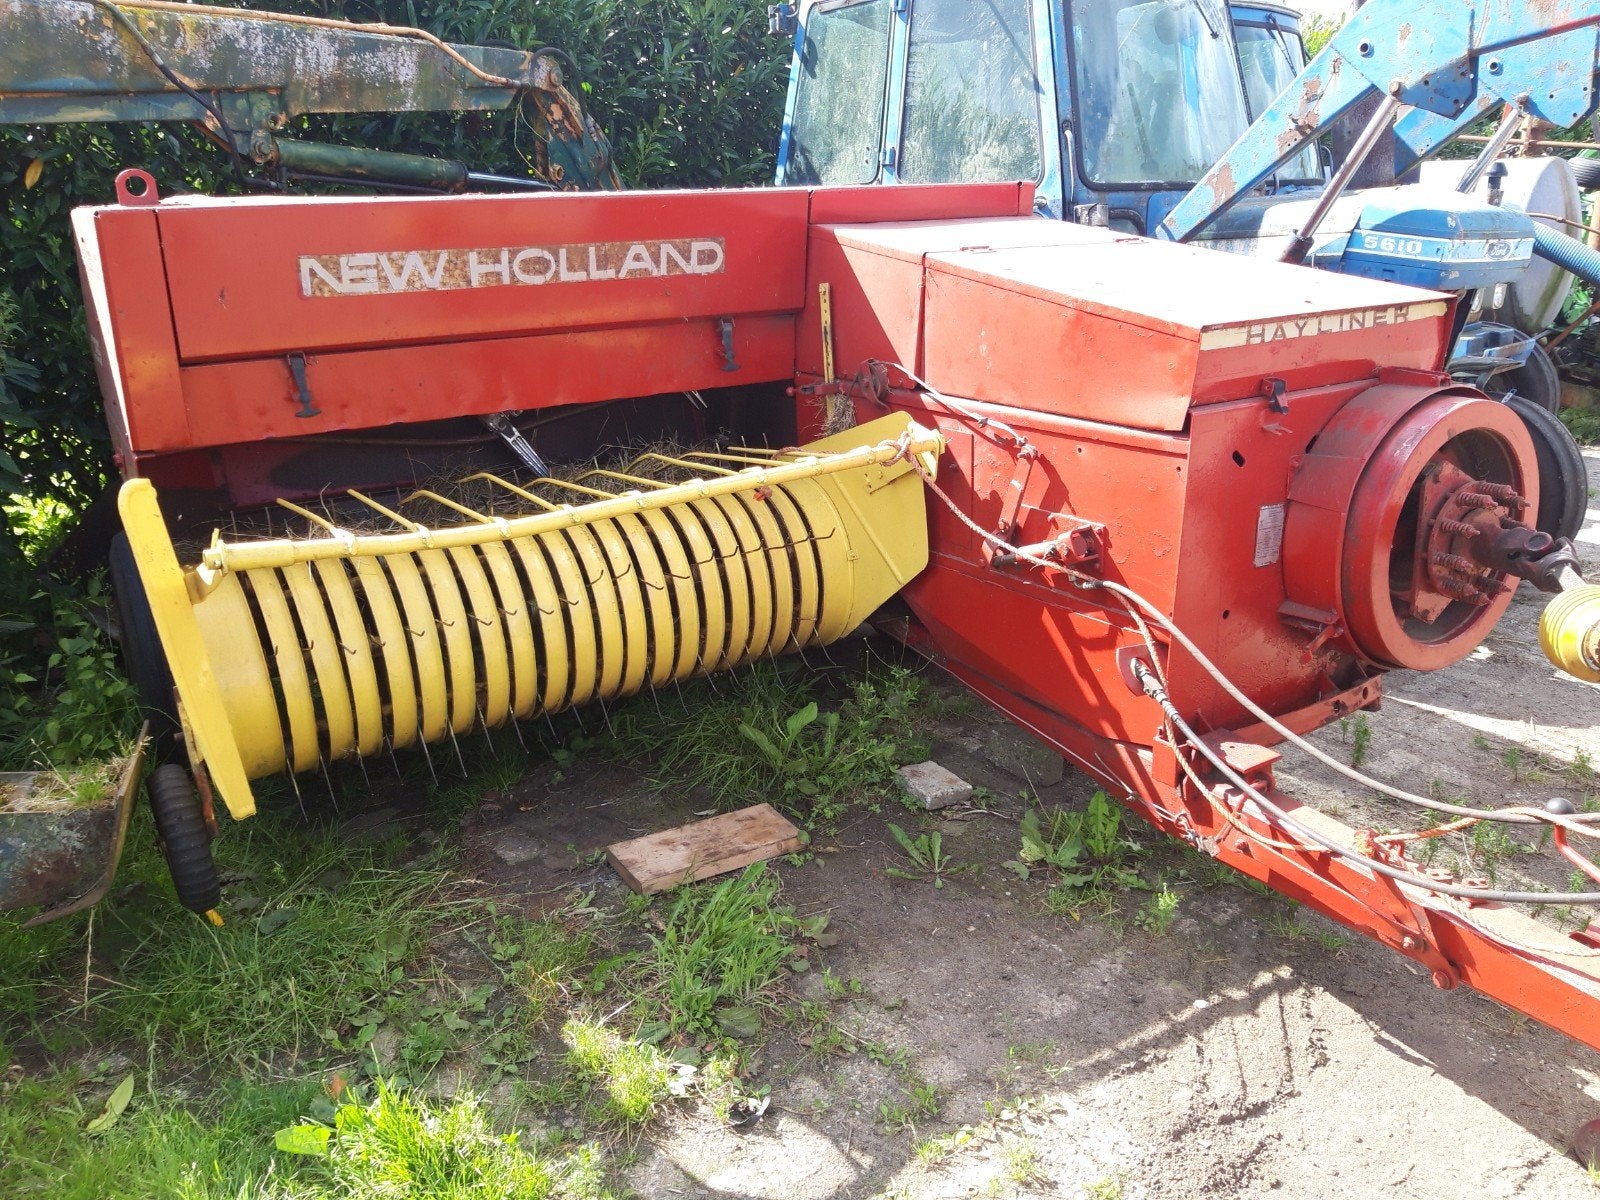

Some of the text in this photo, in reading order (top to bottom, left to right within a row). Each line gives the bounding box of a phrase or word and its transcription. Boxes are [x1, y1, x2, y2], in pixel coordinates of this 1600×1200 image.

[1363, 235, 1422, 254] 5610
[300, 241, 725, 296] NEW HOLLAND
[1246, 306, 1409, 345] HAYLINER
